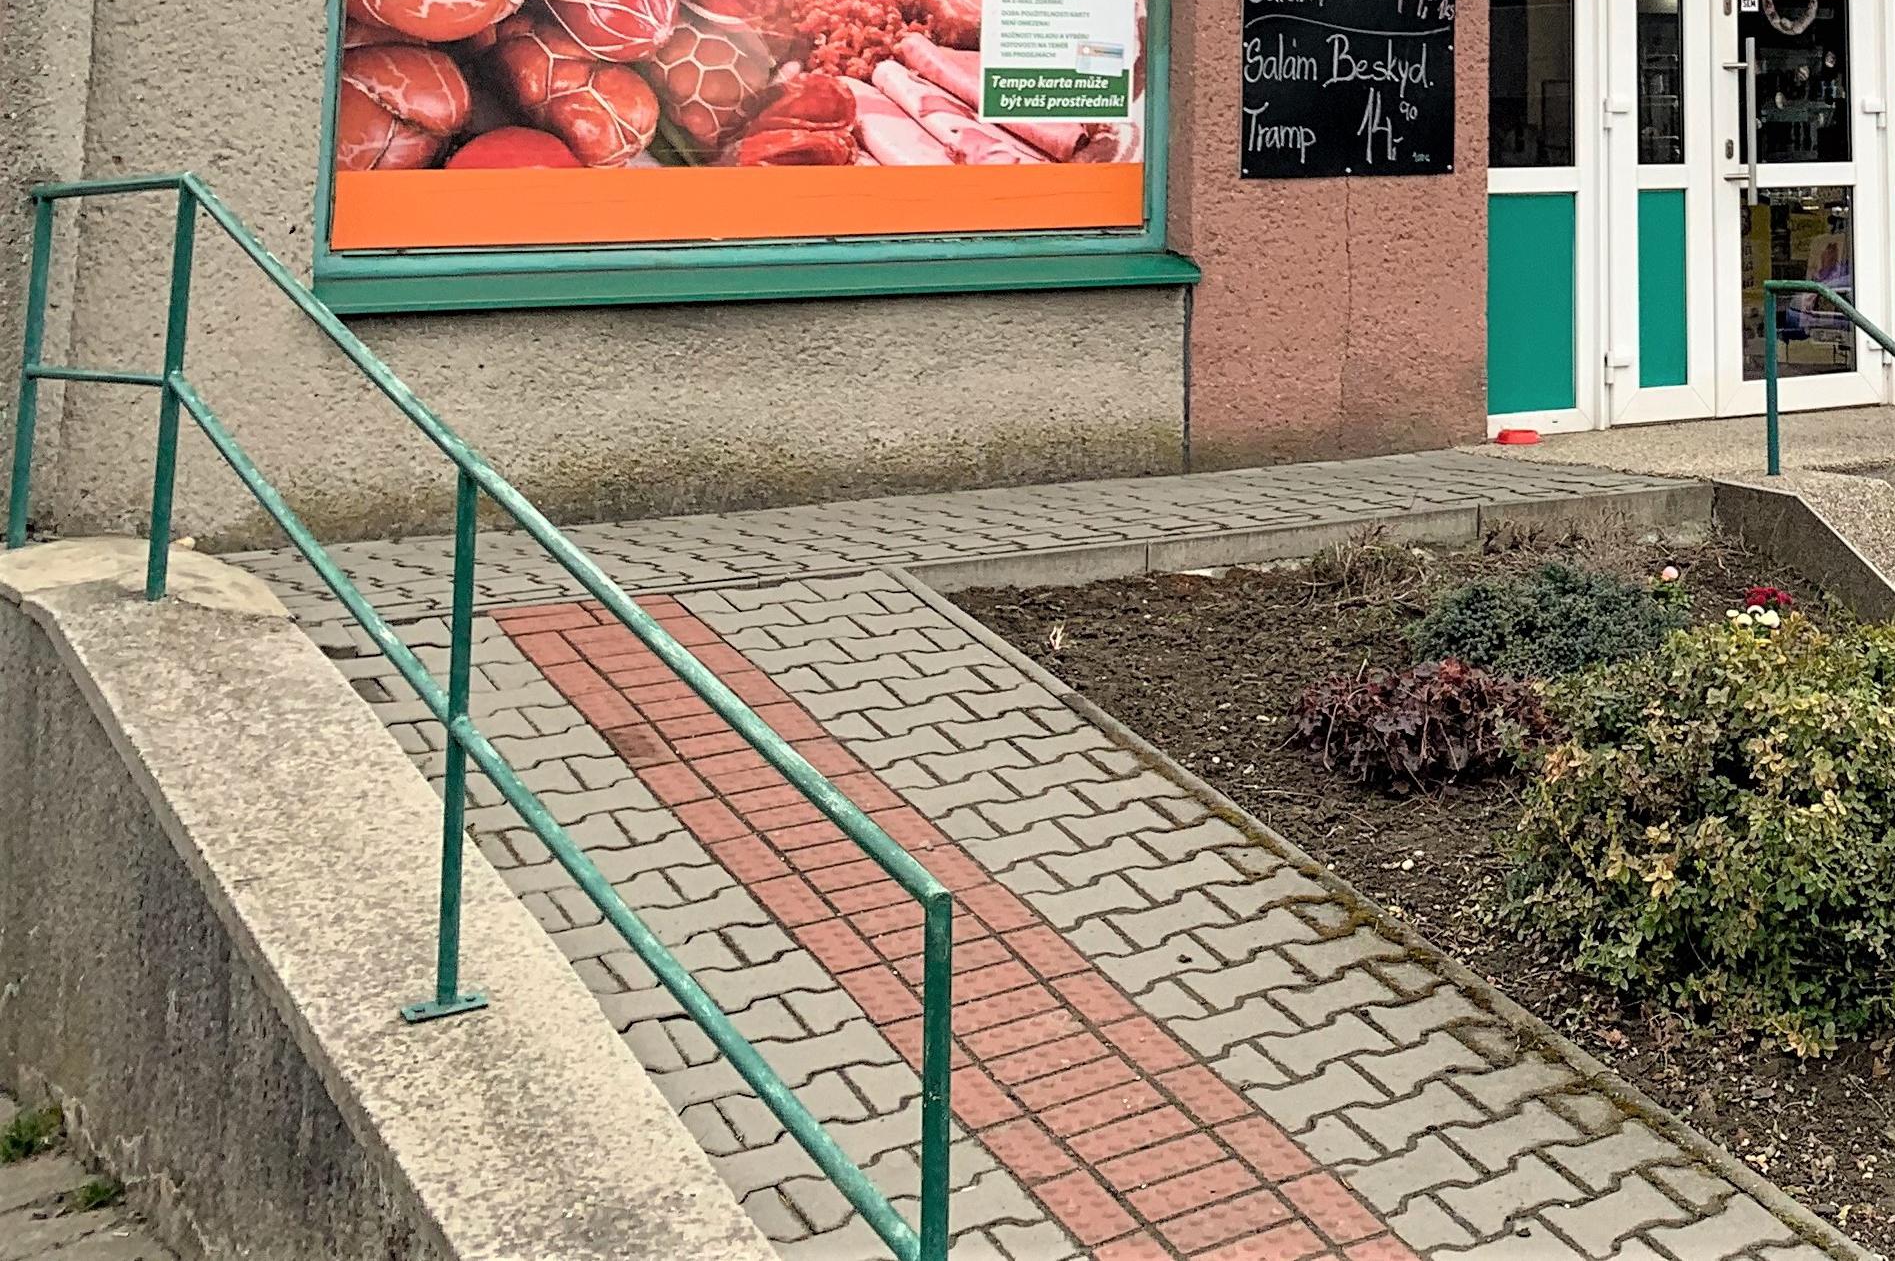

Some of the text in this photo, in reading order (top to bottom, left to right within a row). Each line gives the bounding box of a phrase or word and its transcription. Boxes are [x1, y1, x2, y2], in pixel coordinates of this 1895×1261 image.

[1244, 33, 1318, 82] Salám
[992, 75, 1109, 90] Tempo karta může
[1000, 94, 1126, 110] být váš prostředník!
[1243, 101, 1317, 164] Tramp
